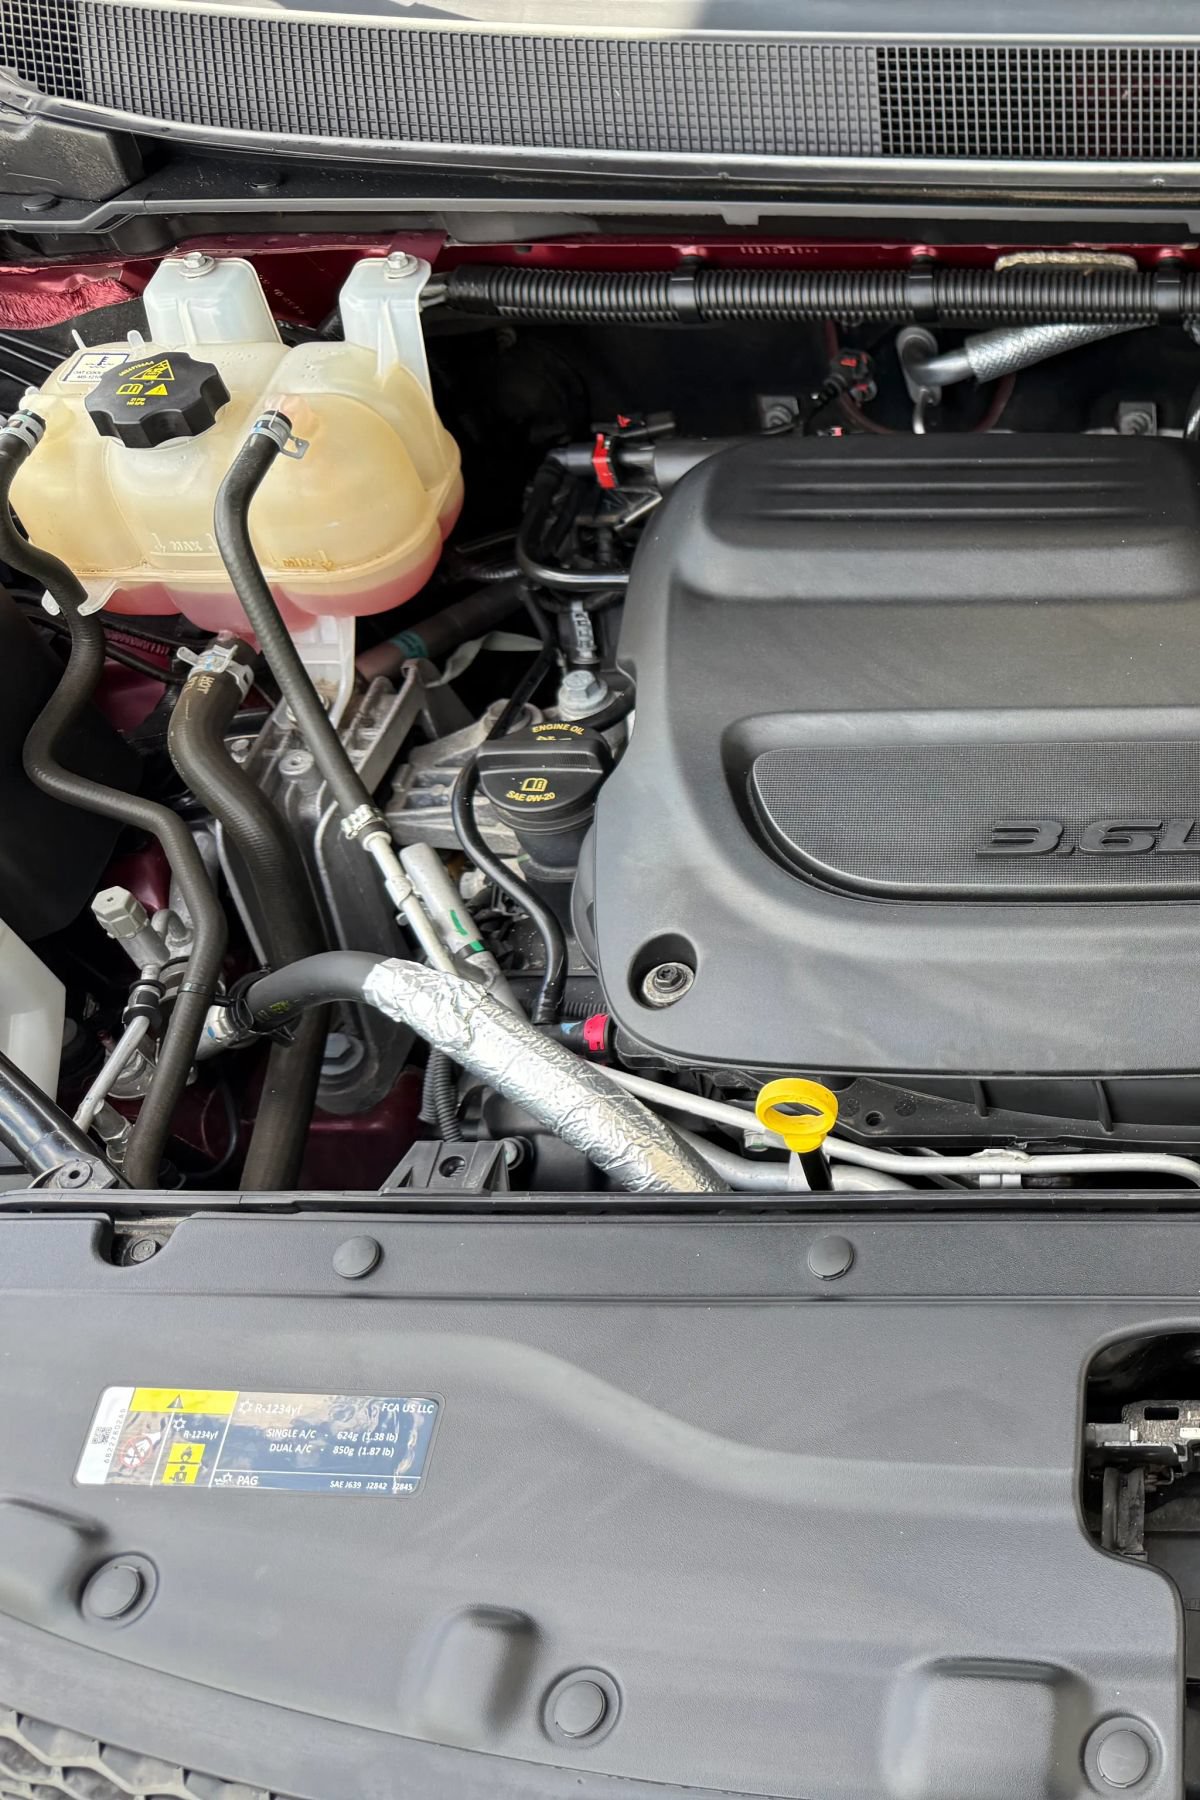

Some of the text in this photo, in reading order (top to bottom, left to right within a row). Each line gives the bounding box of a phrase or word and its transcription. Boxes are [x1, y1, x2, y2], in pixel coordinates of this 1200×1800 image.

[532, 723, 584, 735] ENGINE OIL
[506, 790, 556, 802] SAE 0W-20
[255, 1403, 301, 1416] R-1234yf
[382, 1404, 434, 1414] FCA US LLC
[184, 1430, 219, 1440] R-1234yf
[266, 1428, 399, 1443] SINGLE A/C 624g (1.38 lb)
[269, 1444, 395, 1458] DUAL A/C 850g (1.87 lb)
[236, 1476, 259, 1486] PAG
[330, 1480, 344, 1488] SAE
[344, 1481, 362, 1489] J639
[366, 1482, 388, 1490] J2842
